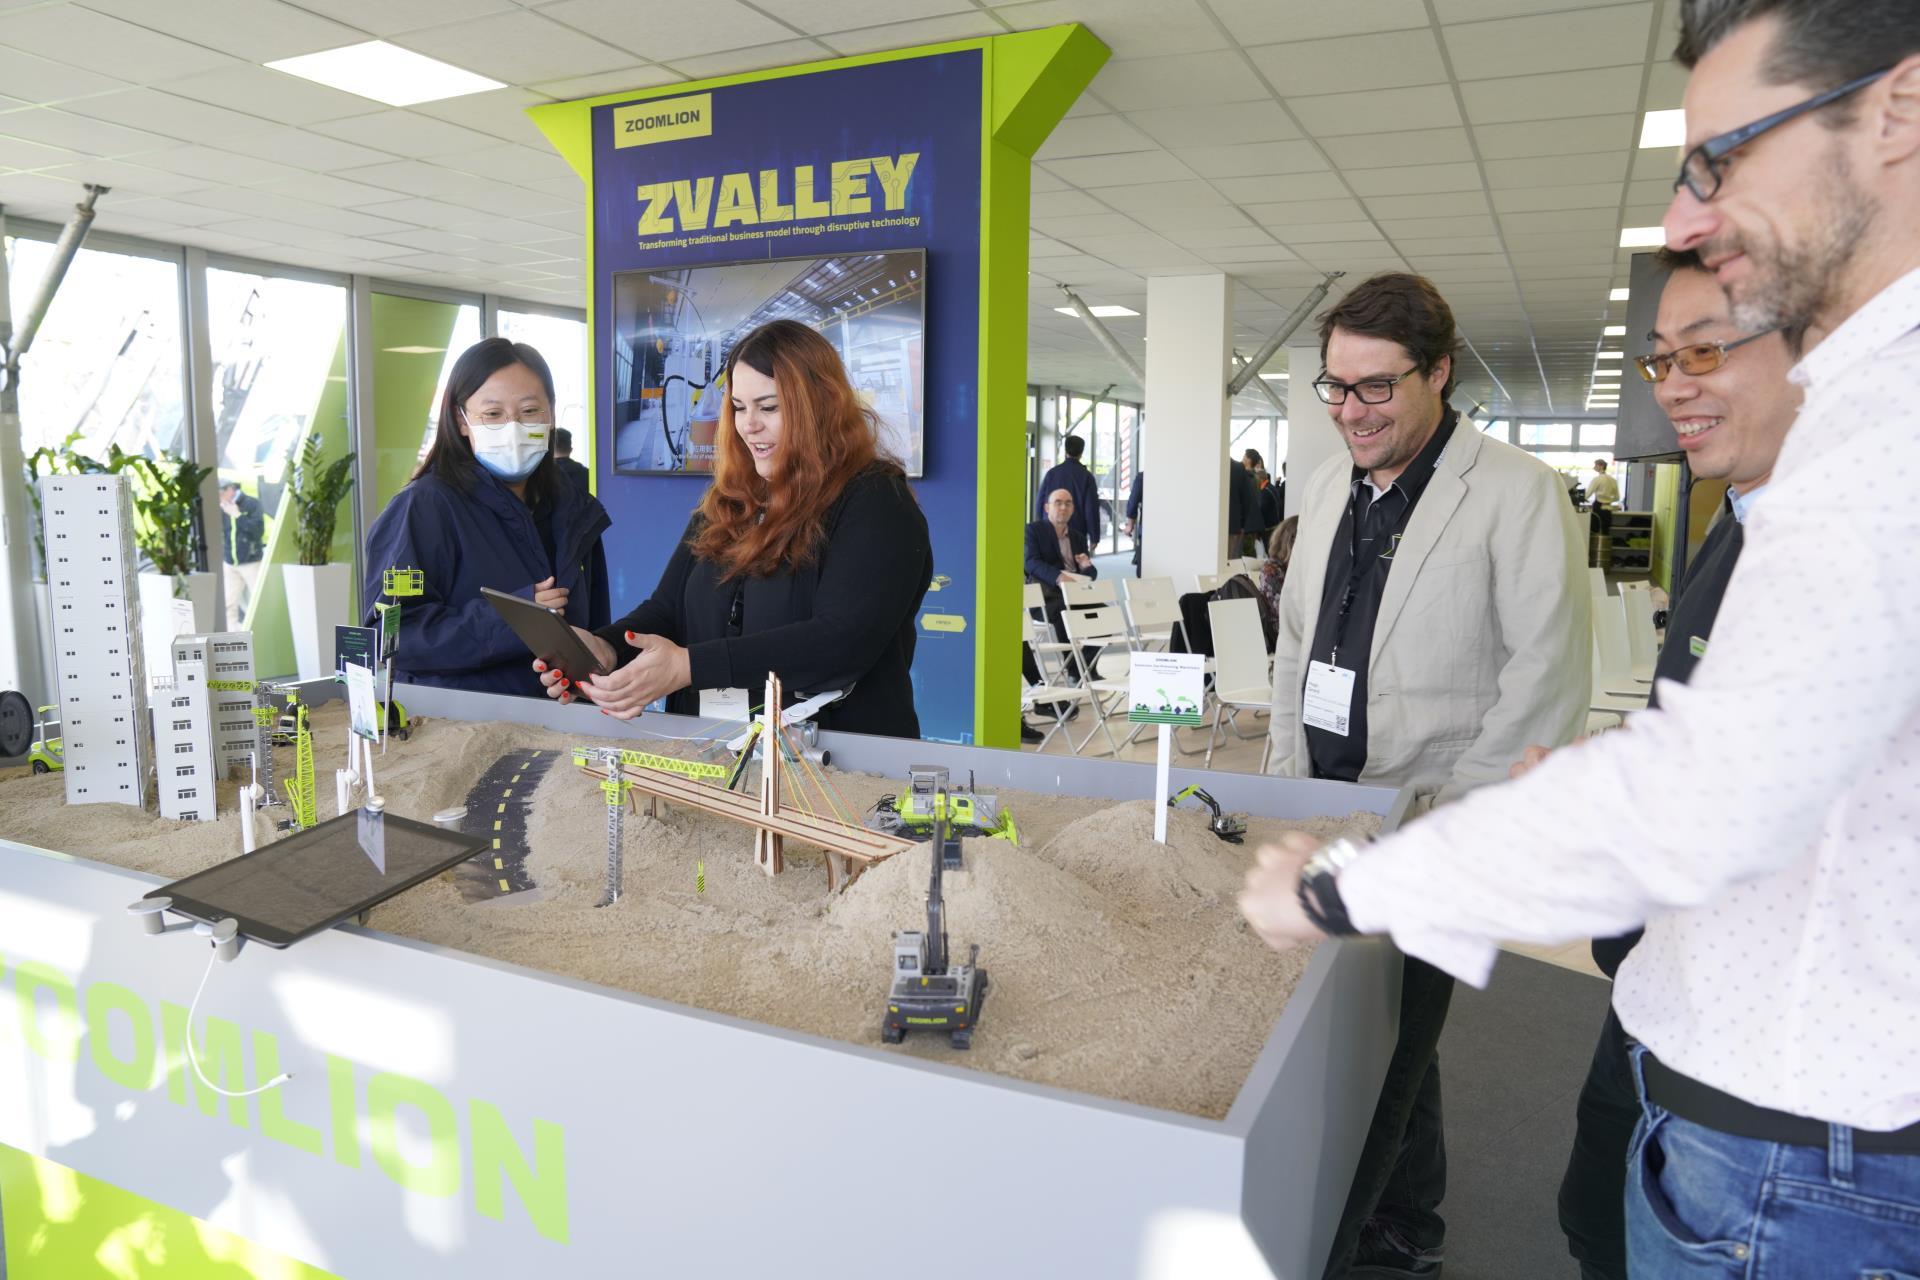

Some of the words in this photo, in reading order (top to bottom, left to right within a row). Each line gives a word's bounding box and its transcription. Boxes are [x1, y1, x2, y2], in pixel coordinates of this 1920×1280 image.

[625, 110, 701, 133] ZOOMLION
[637, 153, 921, 236] ZVALLEY
[638, 239, 688, 251] Transforming
[688, 232, 728, 246] traditional
[729, 230, 764, 241] business
[765, 226, 791, 238] model
[792, 223, 826, 236] through
[827, 219, 870, 233] disruptive
[871, 216, 920, 227] technology
[0, 948, 570, 1246] OOMLION
